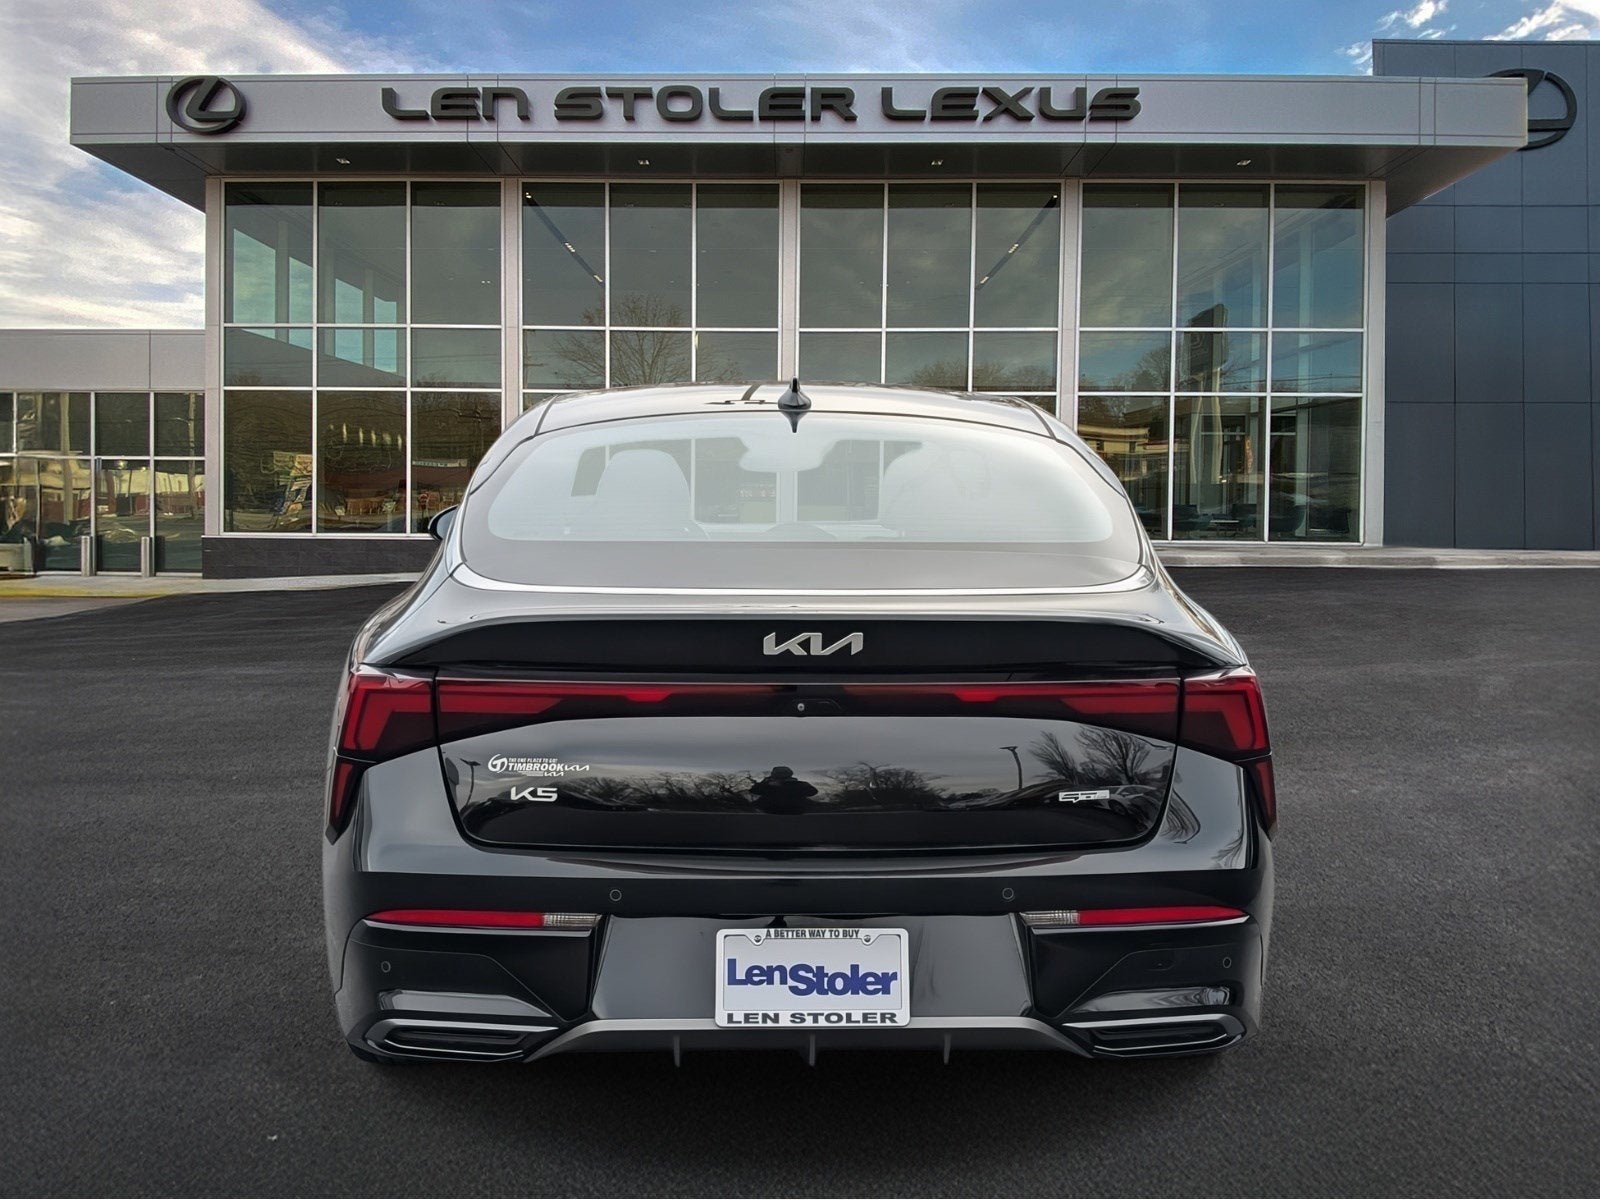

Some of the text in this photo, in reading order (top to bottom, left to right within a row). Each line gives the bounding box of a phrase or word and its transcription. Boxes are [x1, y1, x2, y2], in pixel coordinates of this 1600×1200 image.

[381, 84, 1142, 122] LEN STOLER LEXUS
[763, 631, 864, 656] KIA
[508, 763, 564, 772] TIMBROOK
[511, 786, 558, 802] K5
[765, 929, 860, 938] A BETTER WAY TO BUY
[727, 1012, 899, 1025] LEN STOLER
